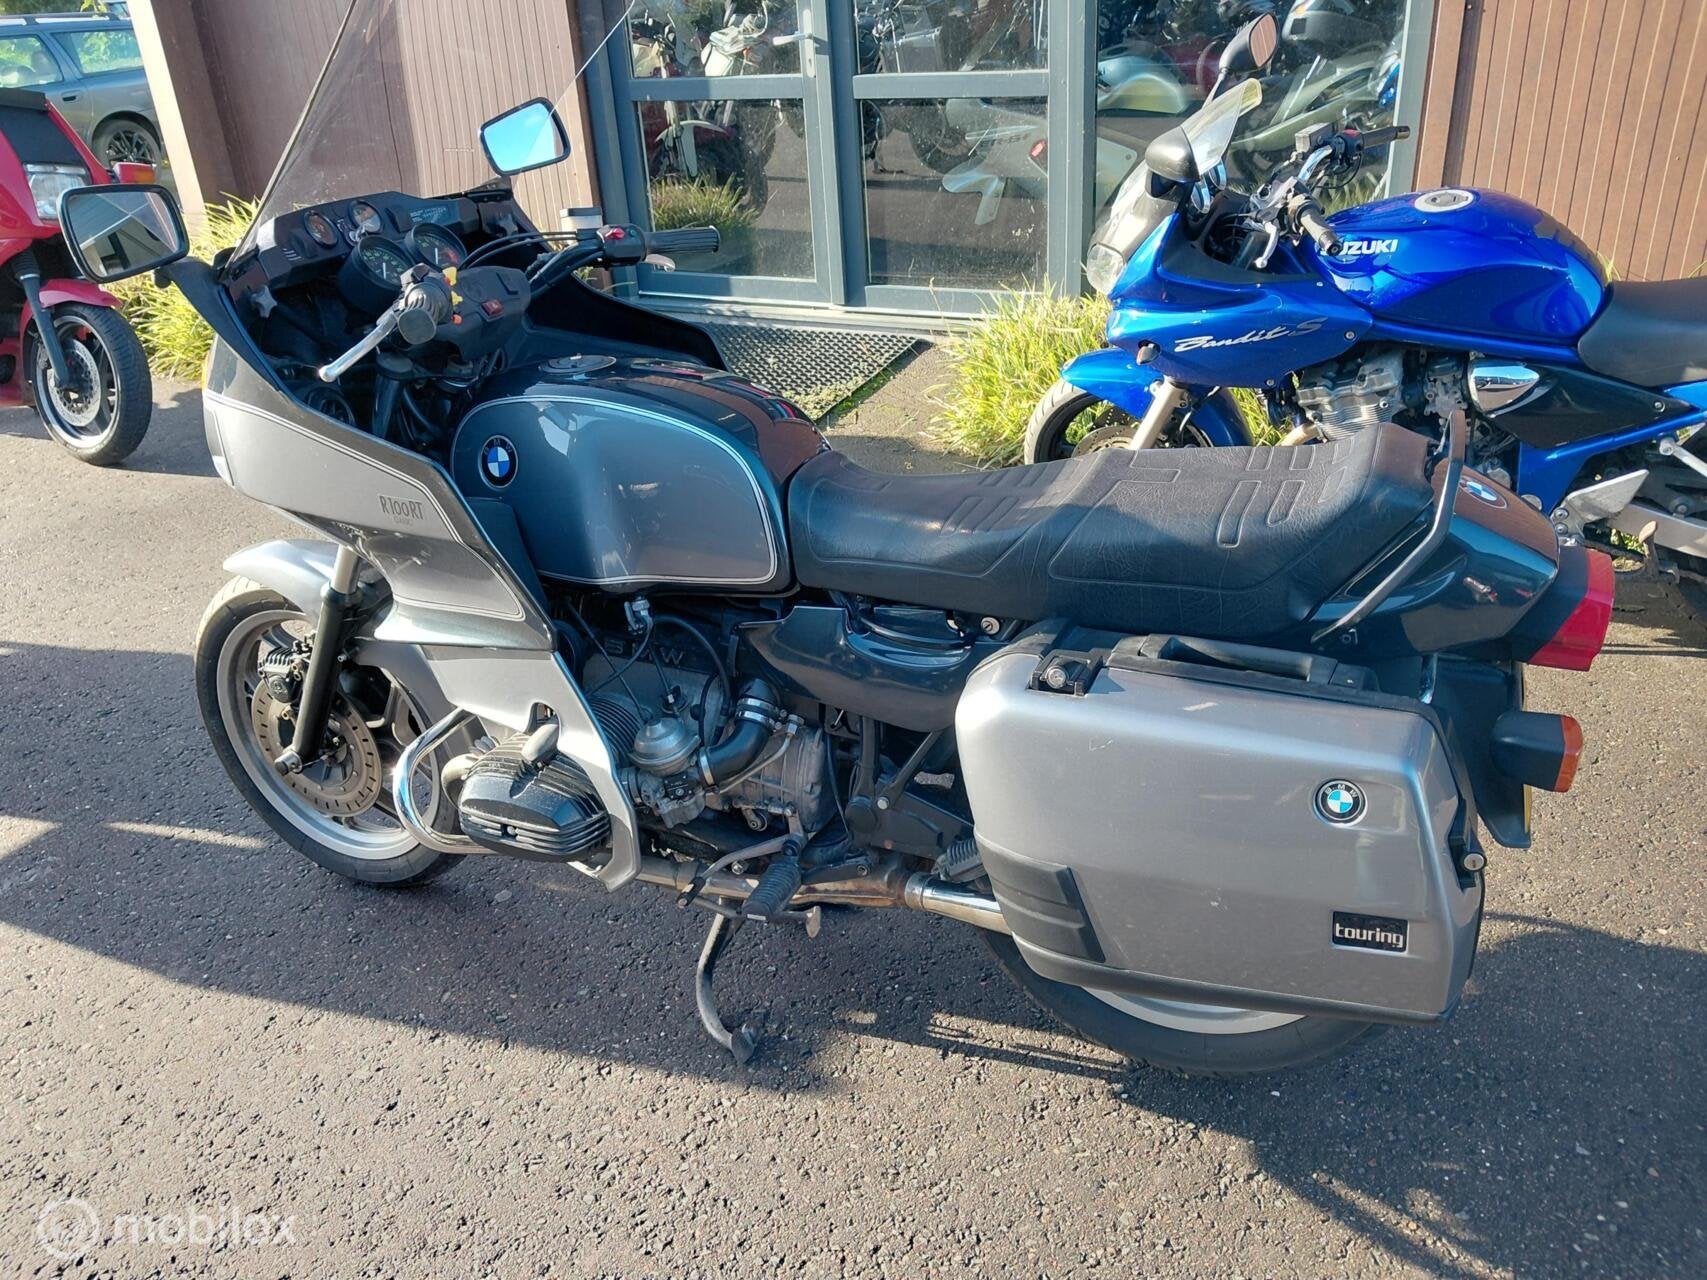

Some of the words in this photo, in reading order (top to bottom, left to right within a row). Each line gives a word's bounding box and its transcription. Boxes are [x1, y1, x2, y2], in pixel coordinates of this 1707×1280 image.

[1320, 239, 1398, 256] UZUKI
[1174, 325, 1290, 352] Bandit
[1288, 317, 1328, 337] S
[1335, 922, 1404, 949] touring
